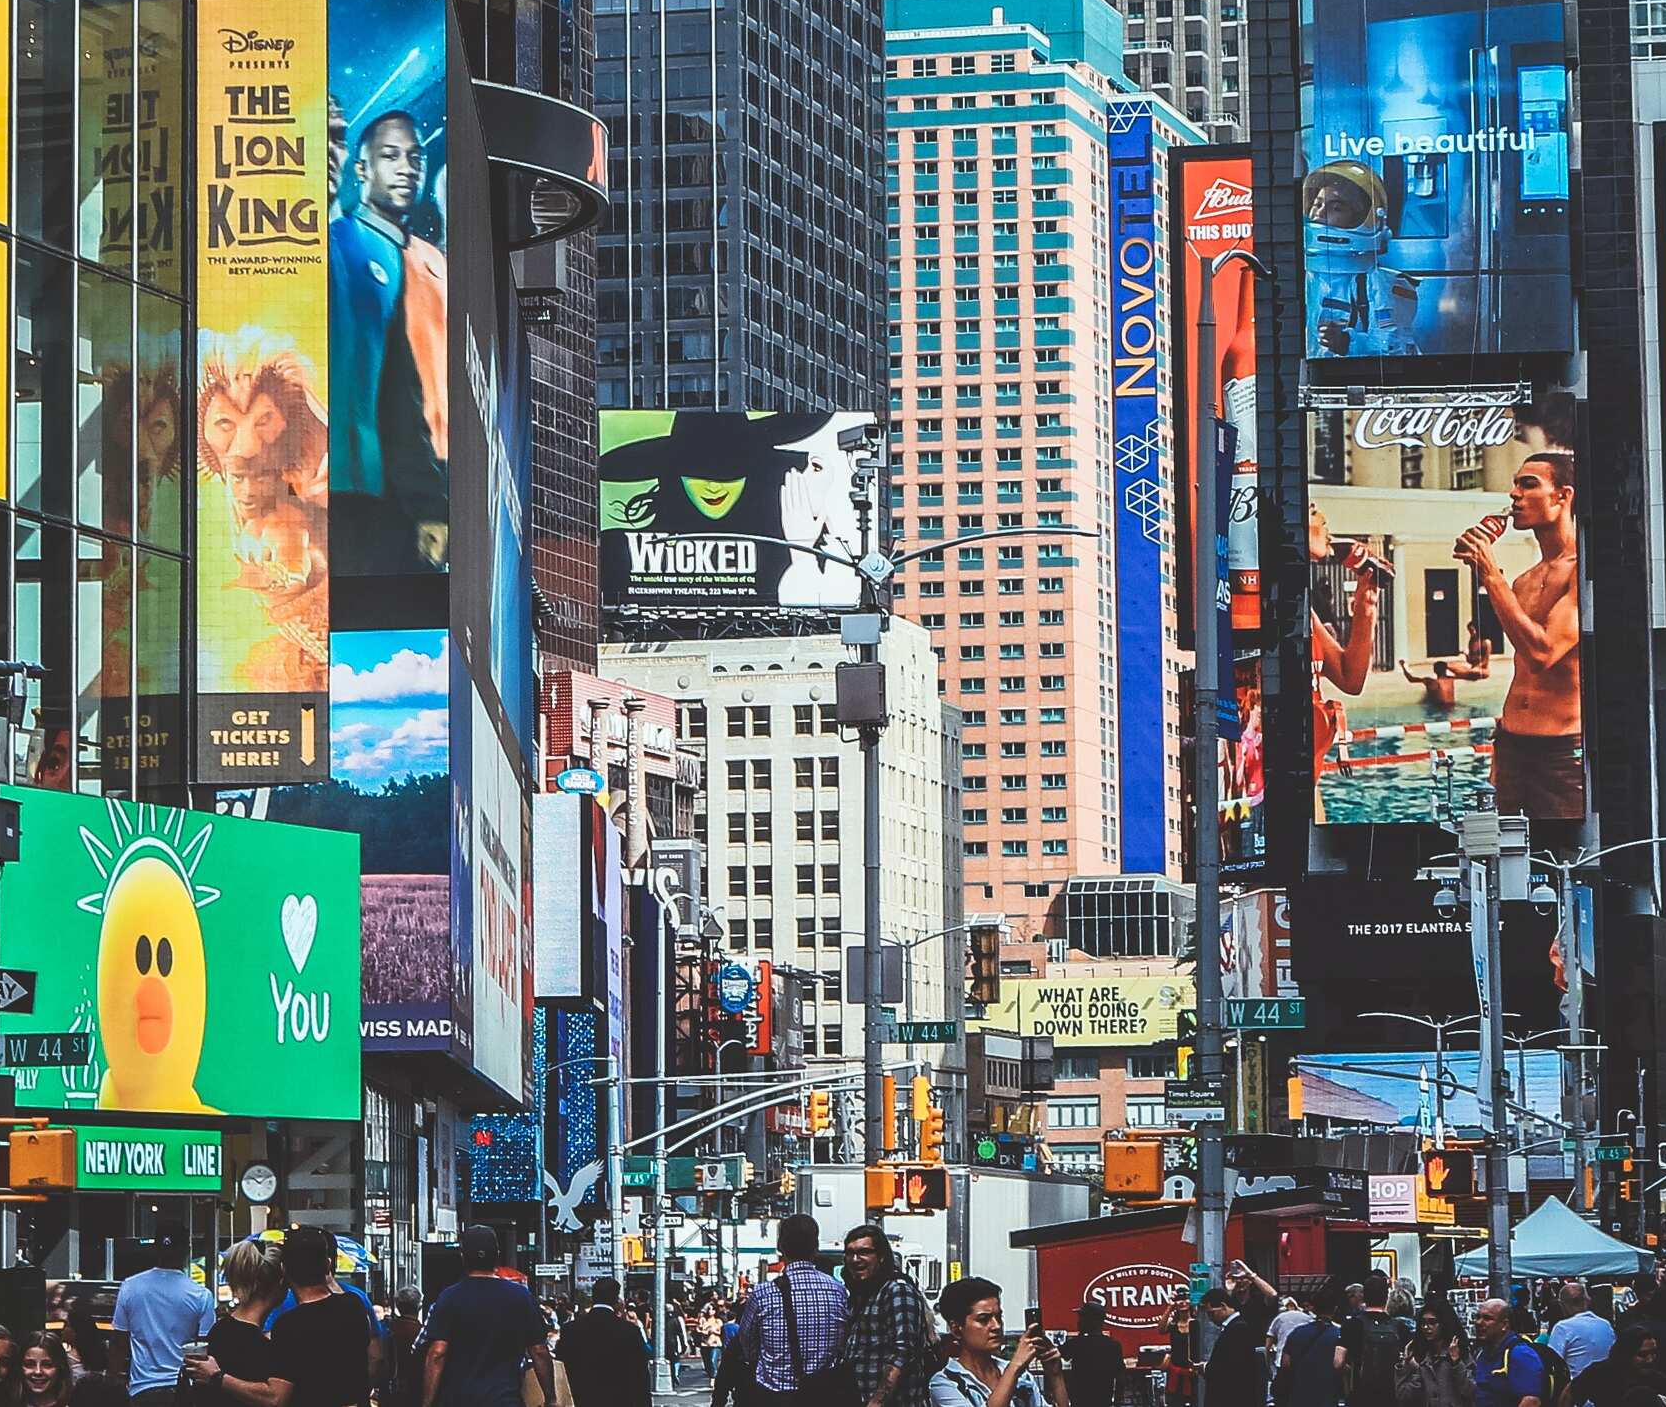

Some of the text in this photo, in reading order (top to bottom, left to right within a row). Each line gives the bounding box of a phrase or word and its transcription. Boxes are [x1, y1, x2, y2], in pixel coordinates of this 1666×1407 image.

[218, 28, 294, 59] Disney
[229, 60, 290, 69] PRESENTS
[225, 85, 291, 116] THE
[1324, 125, 1535, 157] Live beautiful
[214, 125, 306, 179] LION
[207, 184, 319, 249] KING
[1188, 225, 1220, 241] THIS
[207, 255, 322, 265] THE AWARD-WINNING
[1112, 131, 1157, 397] NOVOTEL
[229, 266, 299, 276] BEST MUSICAL
[1353, 394, 1517, 449] Coca-Cola
[630, 575, 642, 583] The
[678, 577, 694, 585] story
[739, 575, 746, 583] of
[232, 710, 269, 725] GET
[210, 730, 290, 745] TICKETS
[221, 751, 279, 767] HERE!
[1347, 921, 1462, 937] THE 2017 ELANTRA
[1037, 986, 1120, 1005] WHAT ARE
[270, 971, 331, 1044] YOU
[1051, 1001, 1140, 1020] YOU DOING
[1230, 1002, 1302, 1026] W 44 ST
[902, 1025, 914, 1041] W
[919, 1025, 938, 1040] 44
[1033, 1018, 1147, 1037] DOWN THERE?
[10, 1037, 85, 1063] W 44 St
[13, 1068, 39, 1090] ALLY
[1168, 1090, 1216, 1100] Times Square
[85, 1141, 215, 1175] NEW YORK LINE
